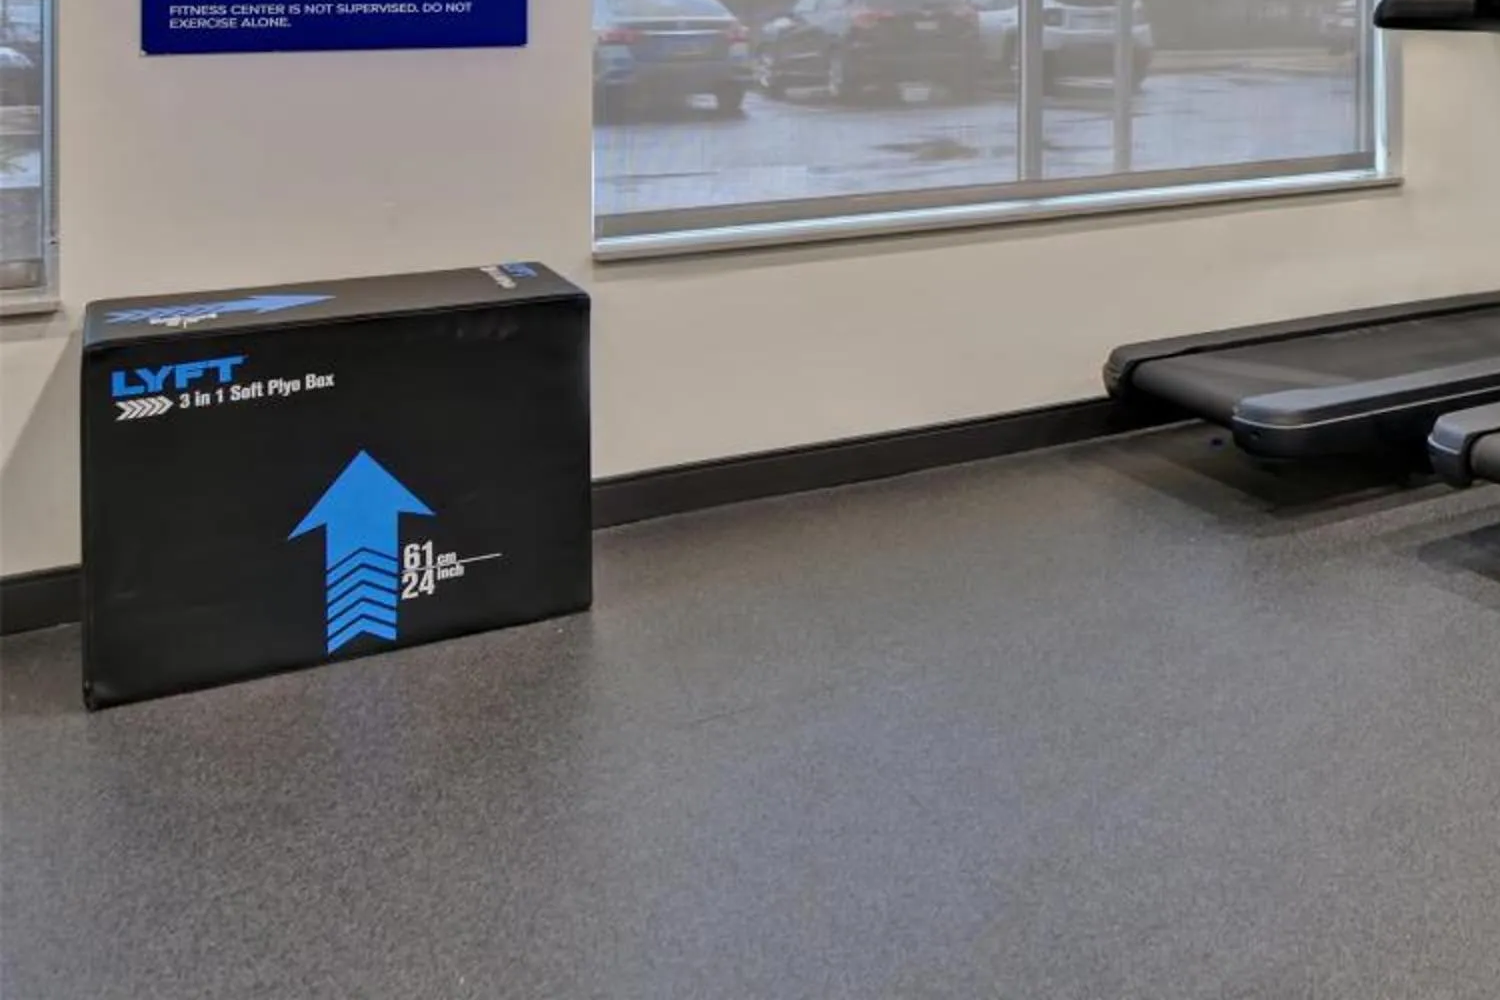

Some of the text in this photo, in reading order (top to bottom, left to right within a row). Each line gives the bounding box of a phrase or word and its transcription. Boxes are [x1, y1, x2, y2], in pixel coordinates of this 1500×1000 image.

[169, 1, 473, 16] FITNESS CENTER IS NOT SUPERVISED. DO NOT
[169, 16, 292, 29] EXERCISE ALONE.
[112, 354, 249, 397] LYFT
[179, 373, 335, 409] 3 in 1 Soft Plyo Box
[403, 540, 457, 569] 61 cm
[401, 563, 465, 600] 24 inch
